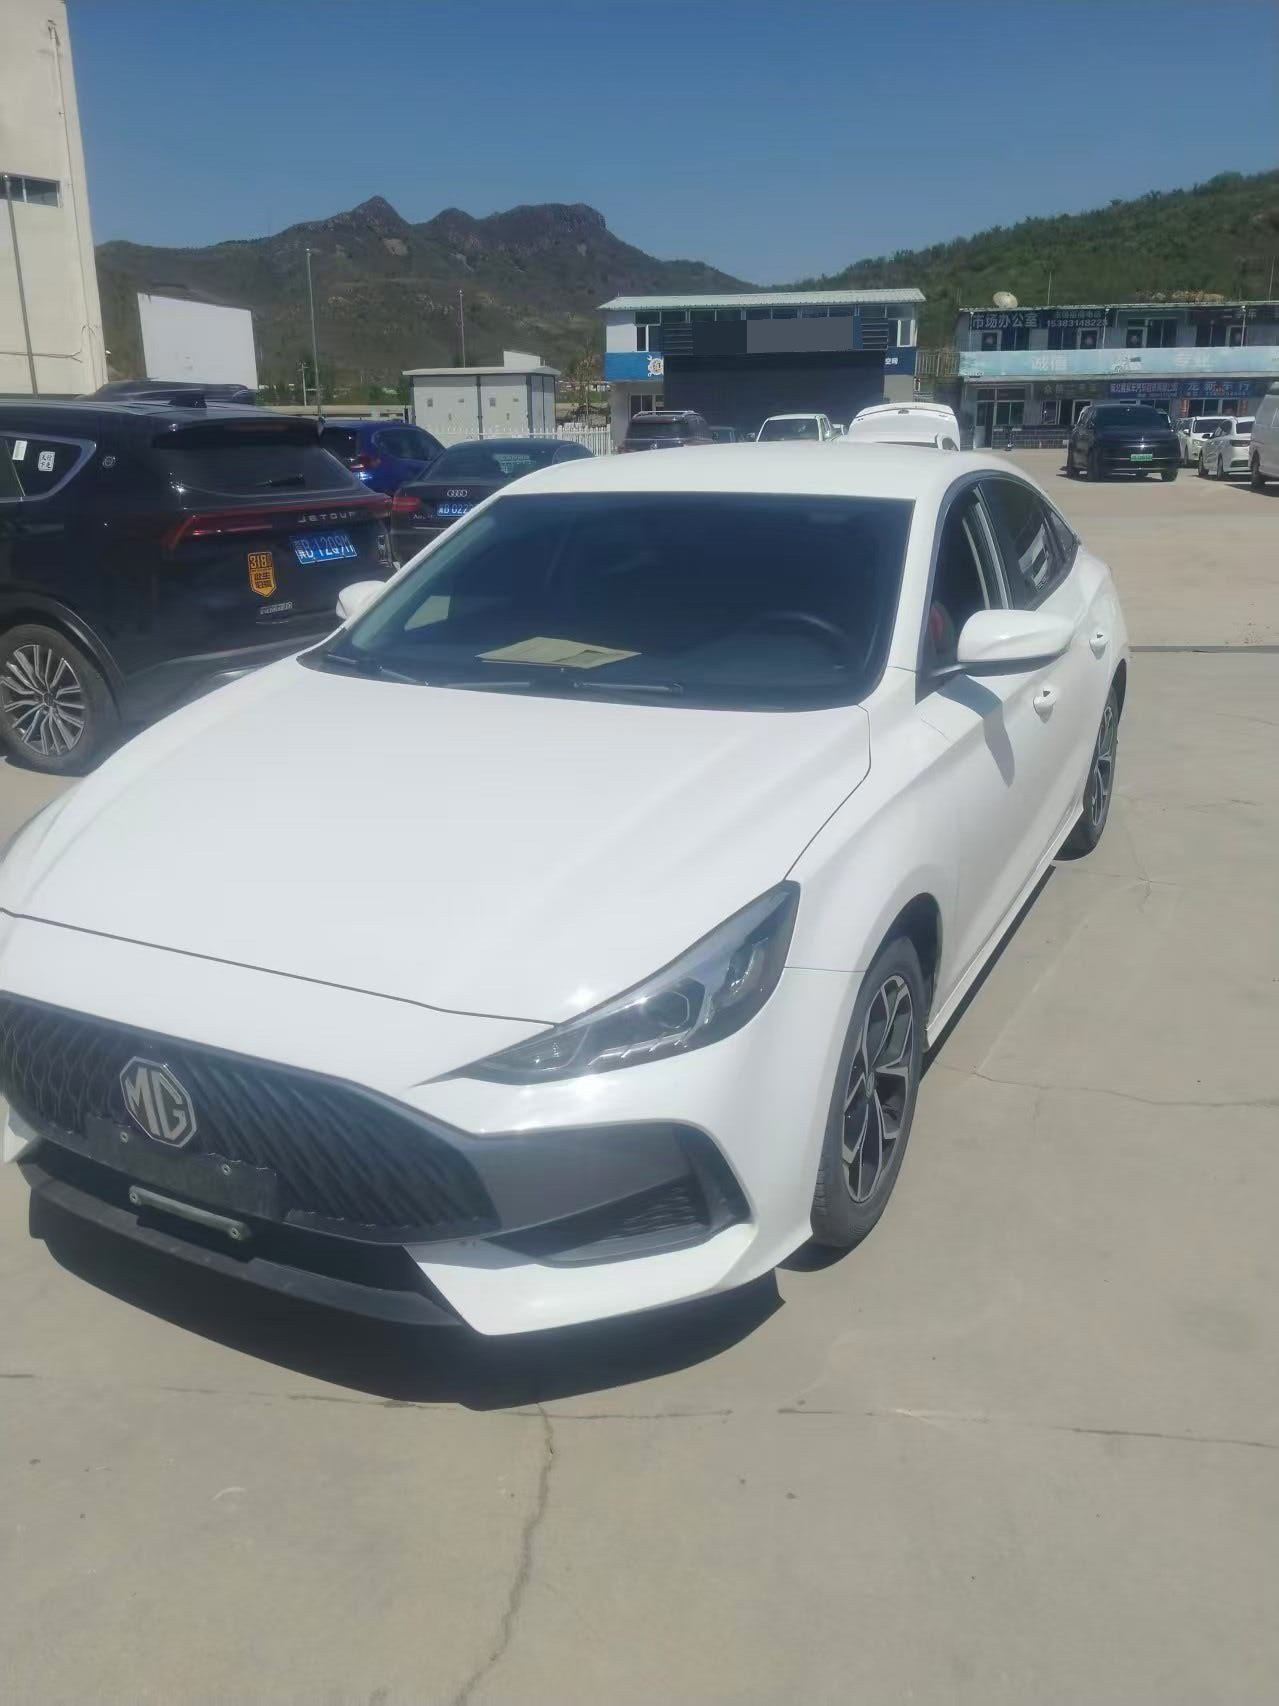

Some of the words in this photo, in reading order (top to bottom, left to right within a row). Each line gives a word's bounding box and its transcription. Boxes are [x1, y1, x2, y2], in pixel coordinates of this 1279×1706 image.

[973, 312, 1040, 328] 市场办公室
[249, 555, 267, 569] 318
[125, 1067, 188, 1141] MG
